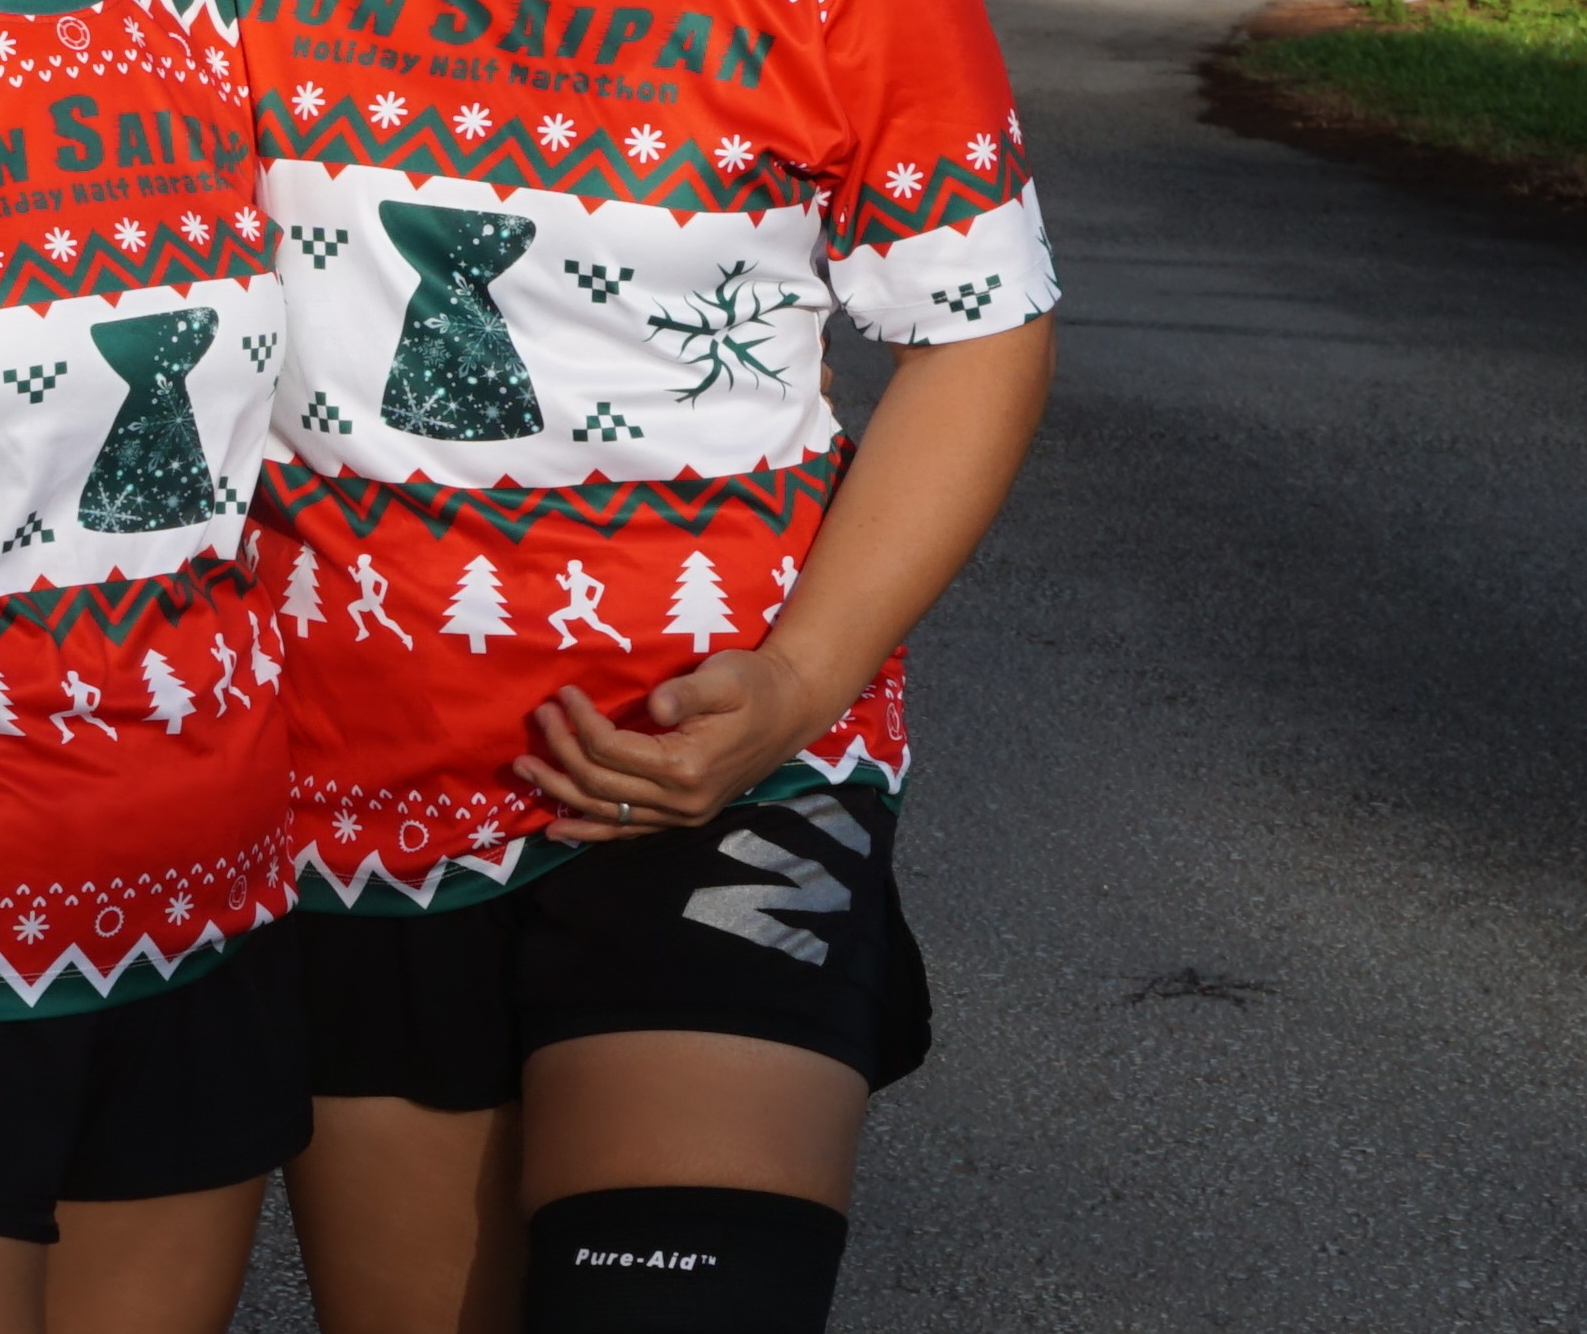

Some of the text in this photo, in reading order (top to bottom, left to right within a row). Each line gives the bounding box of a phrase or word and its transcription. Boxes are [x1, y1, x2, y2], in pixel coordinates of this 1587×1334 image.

[292, 34, 679, 104] Holiday Half Marathon
[73, 180, 132, 205] Half
